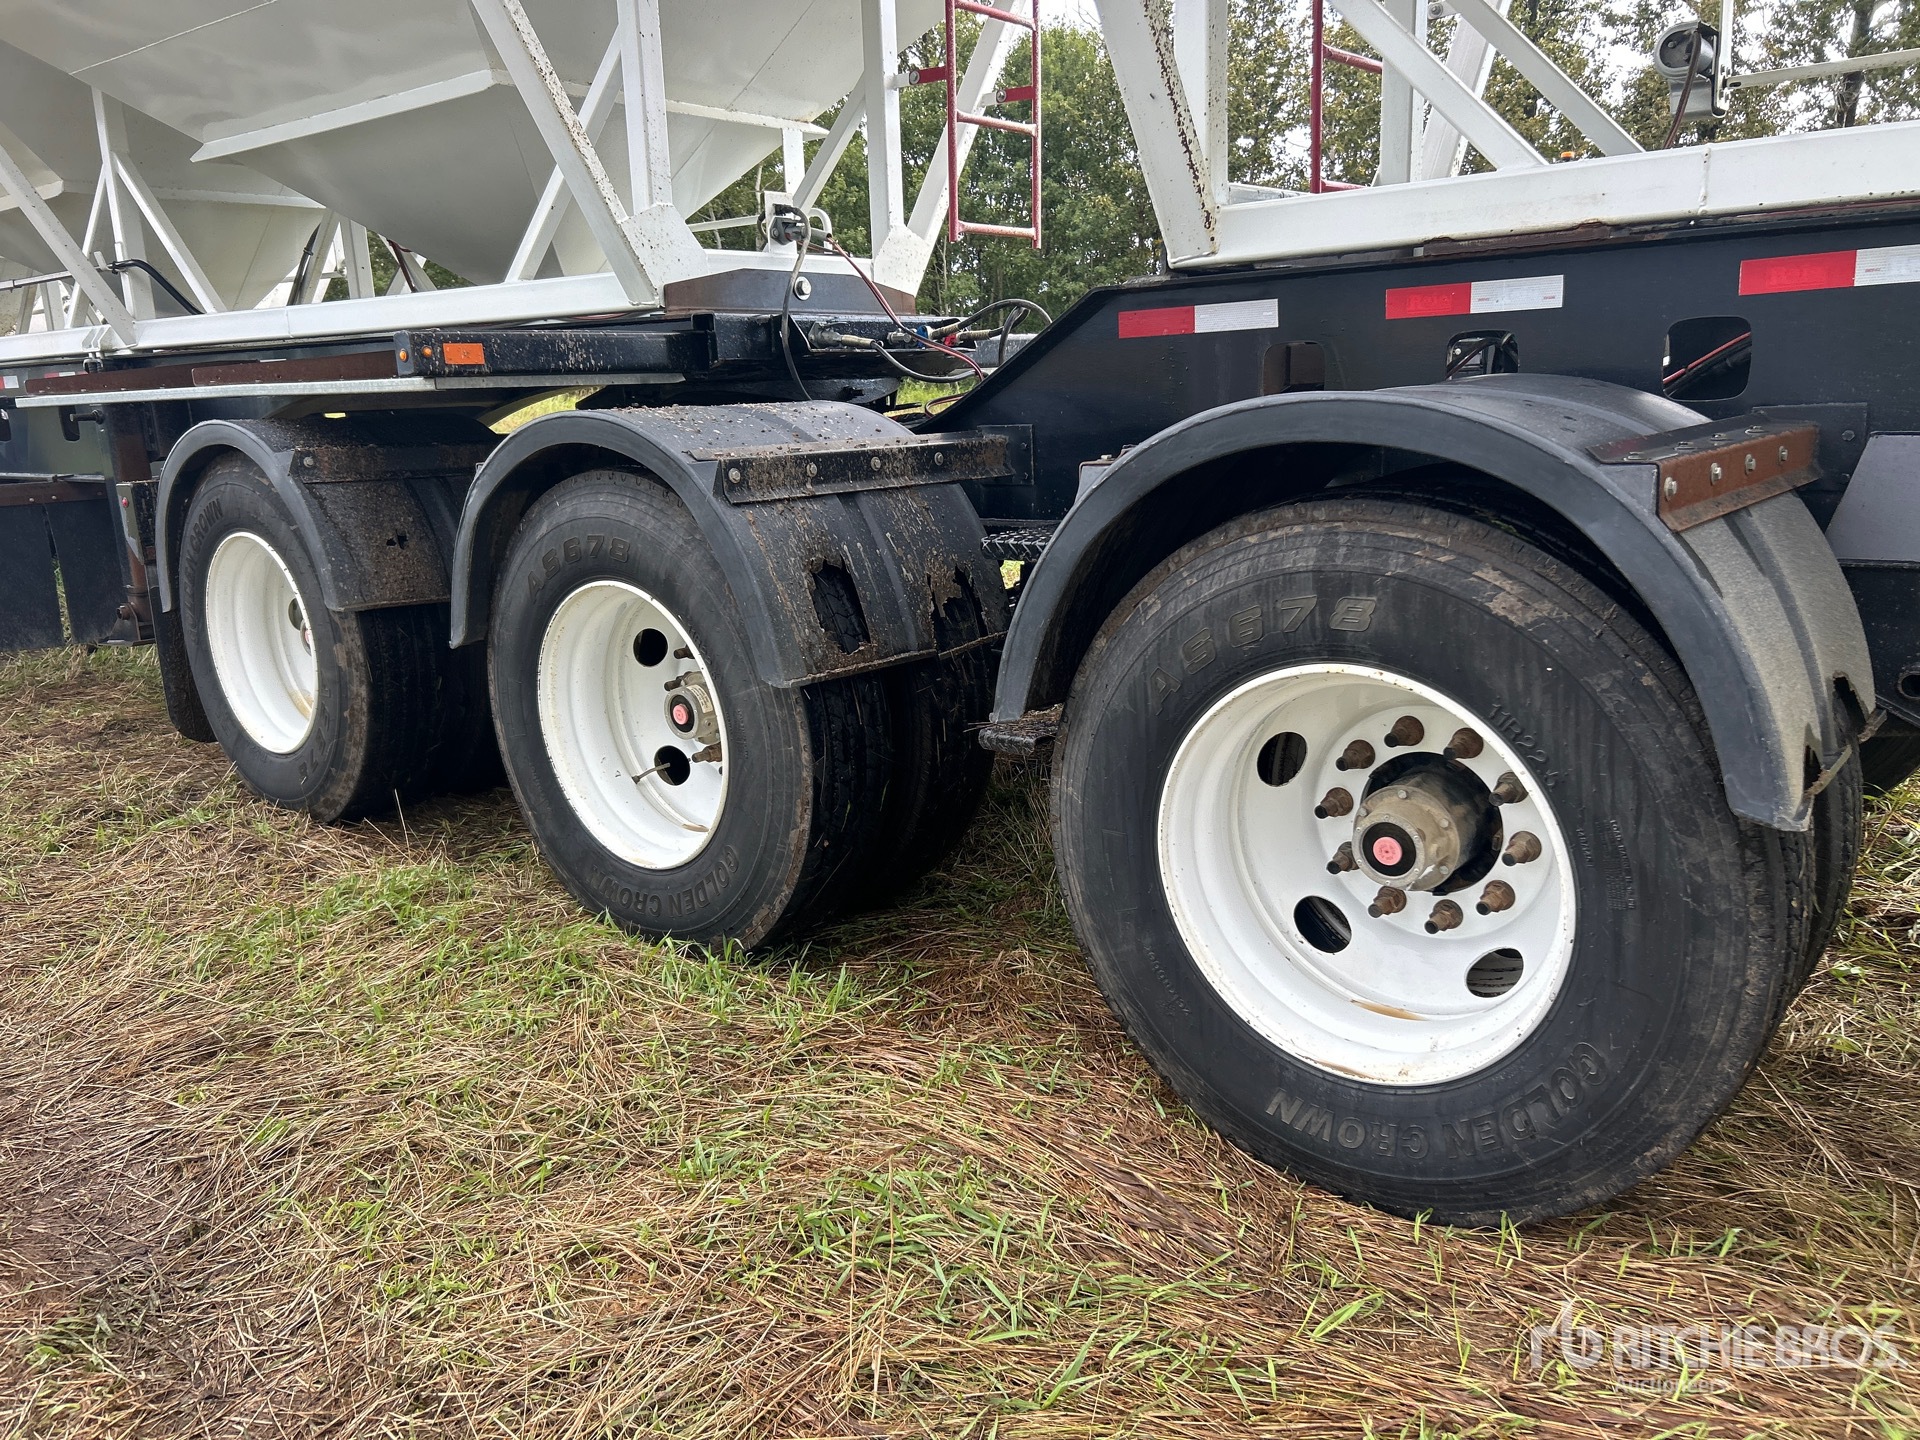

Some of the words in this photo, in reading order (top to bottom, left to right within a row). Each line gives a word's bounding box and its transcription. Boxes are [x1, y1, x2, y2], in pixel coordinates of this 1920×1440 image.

[189, 498, 224, 551] CROWN
[528, 534, 631, 604] AS678
[1147, 594, 1378, 716] AS678
[668, 844, 740, 918] GOLDEN
[1265, 1087, 1430, 1160] CROWN
[1442, 1041, 1610, 1159] GOLDEN
